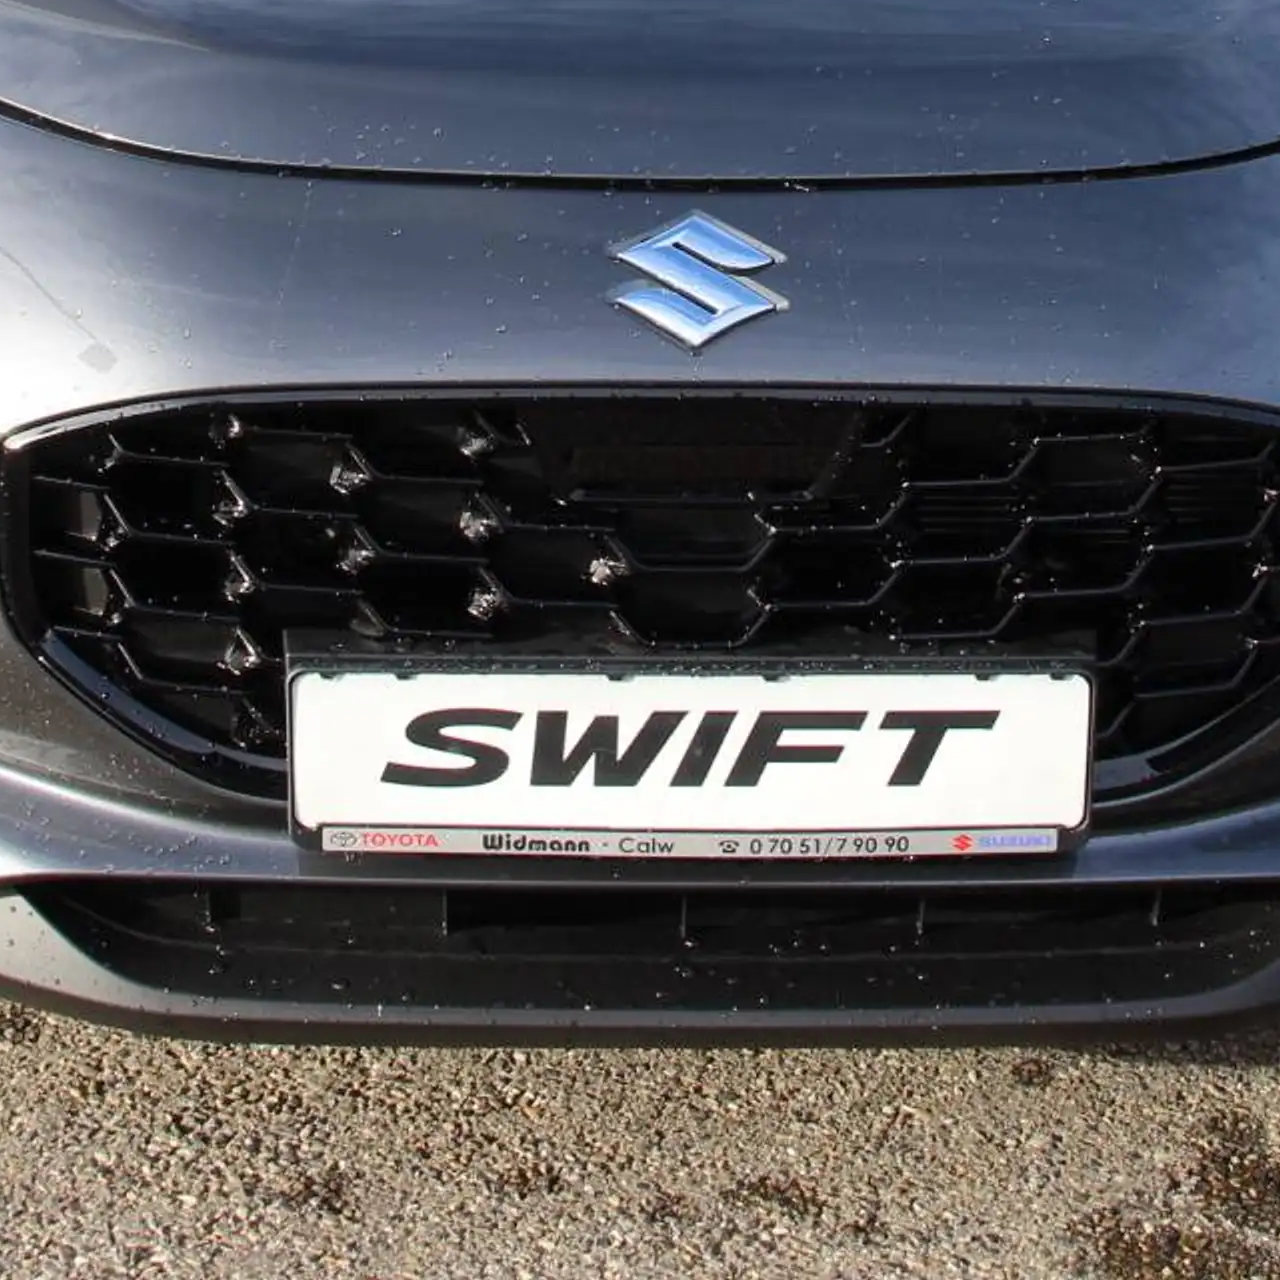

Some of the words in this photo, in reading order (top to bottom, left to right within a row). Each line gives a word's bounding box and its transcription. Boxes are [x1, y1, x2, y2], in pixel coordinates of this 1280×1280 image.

[379, 707, 1001, 788] SWIFT
[362, 832, 439, 848] TOYOTA
[482, 832, 590, 853] Widmann
[618, 836, 675, 854] Calw
